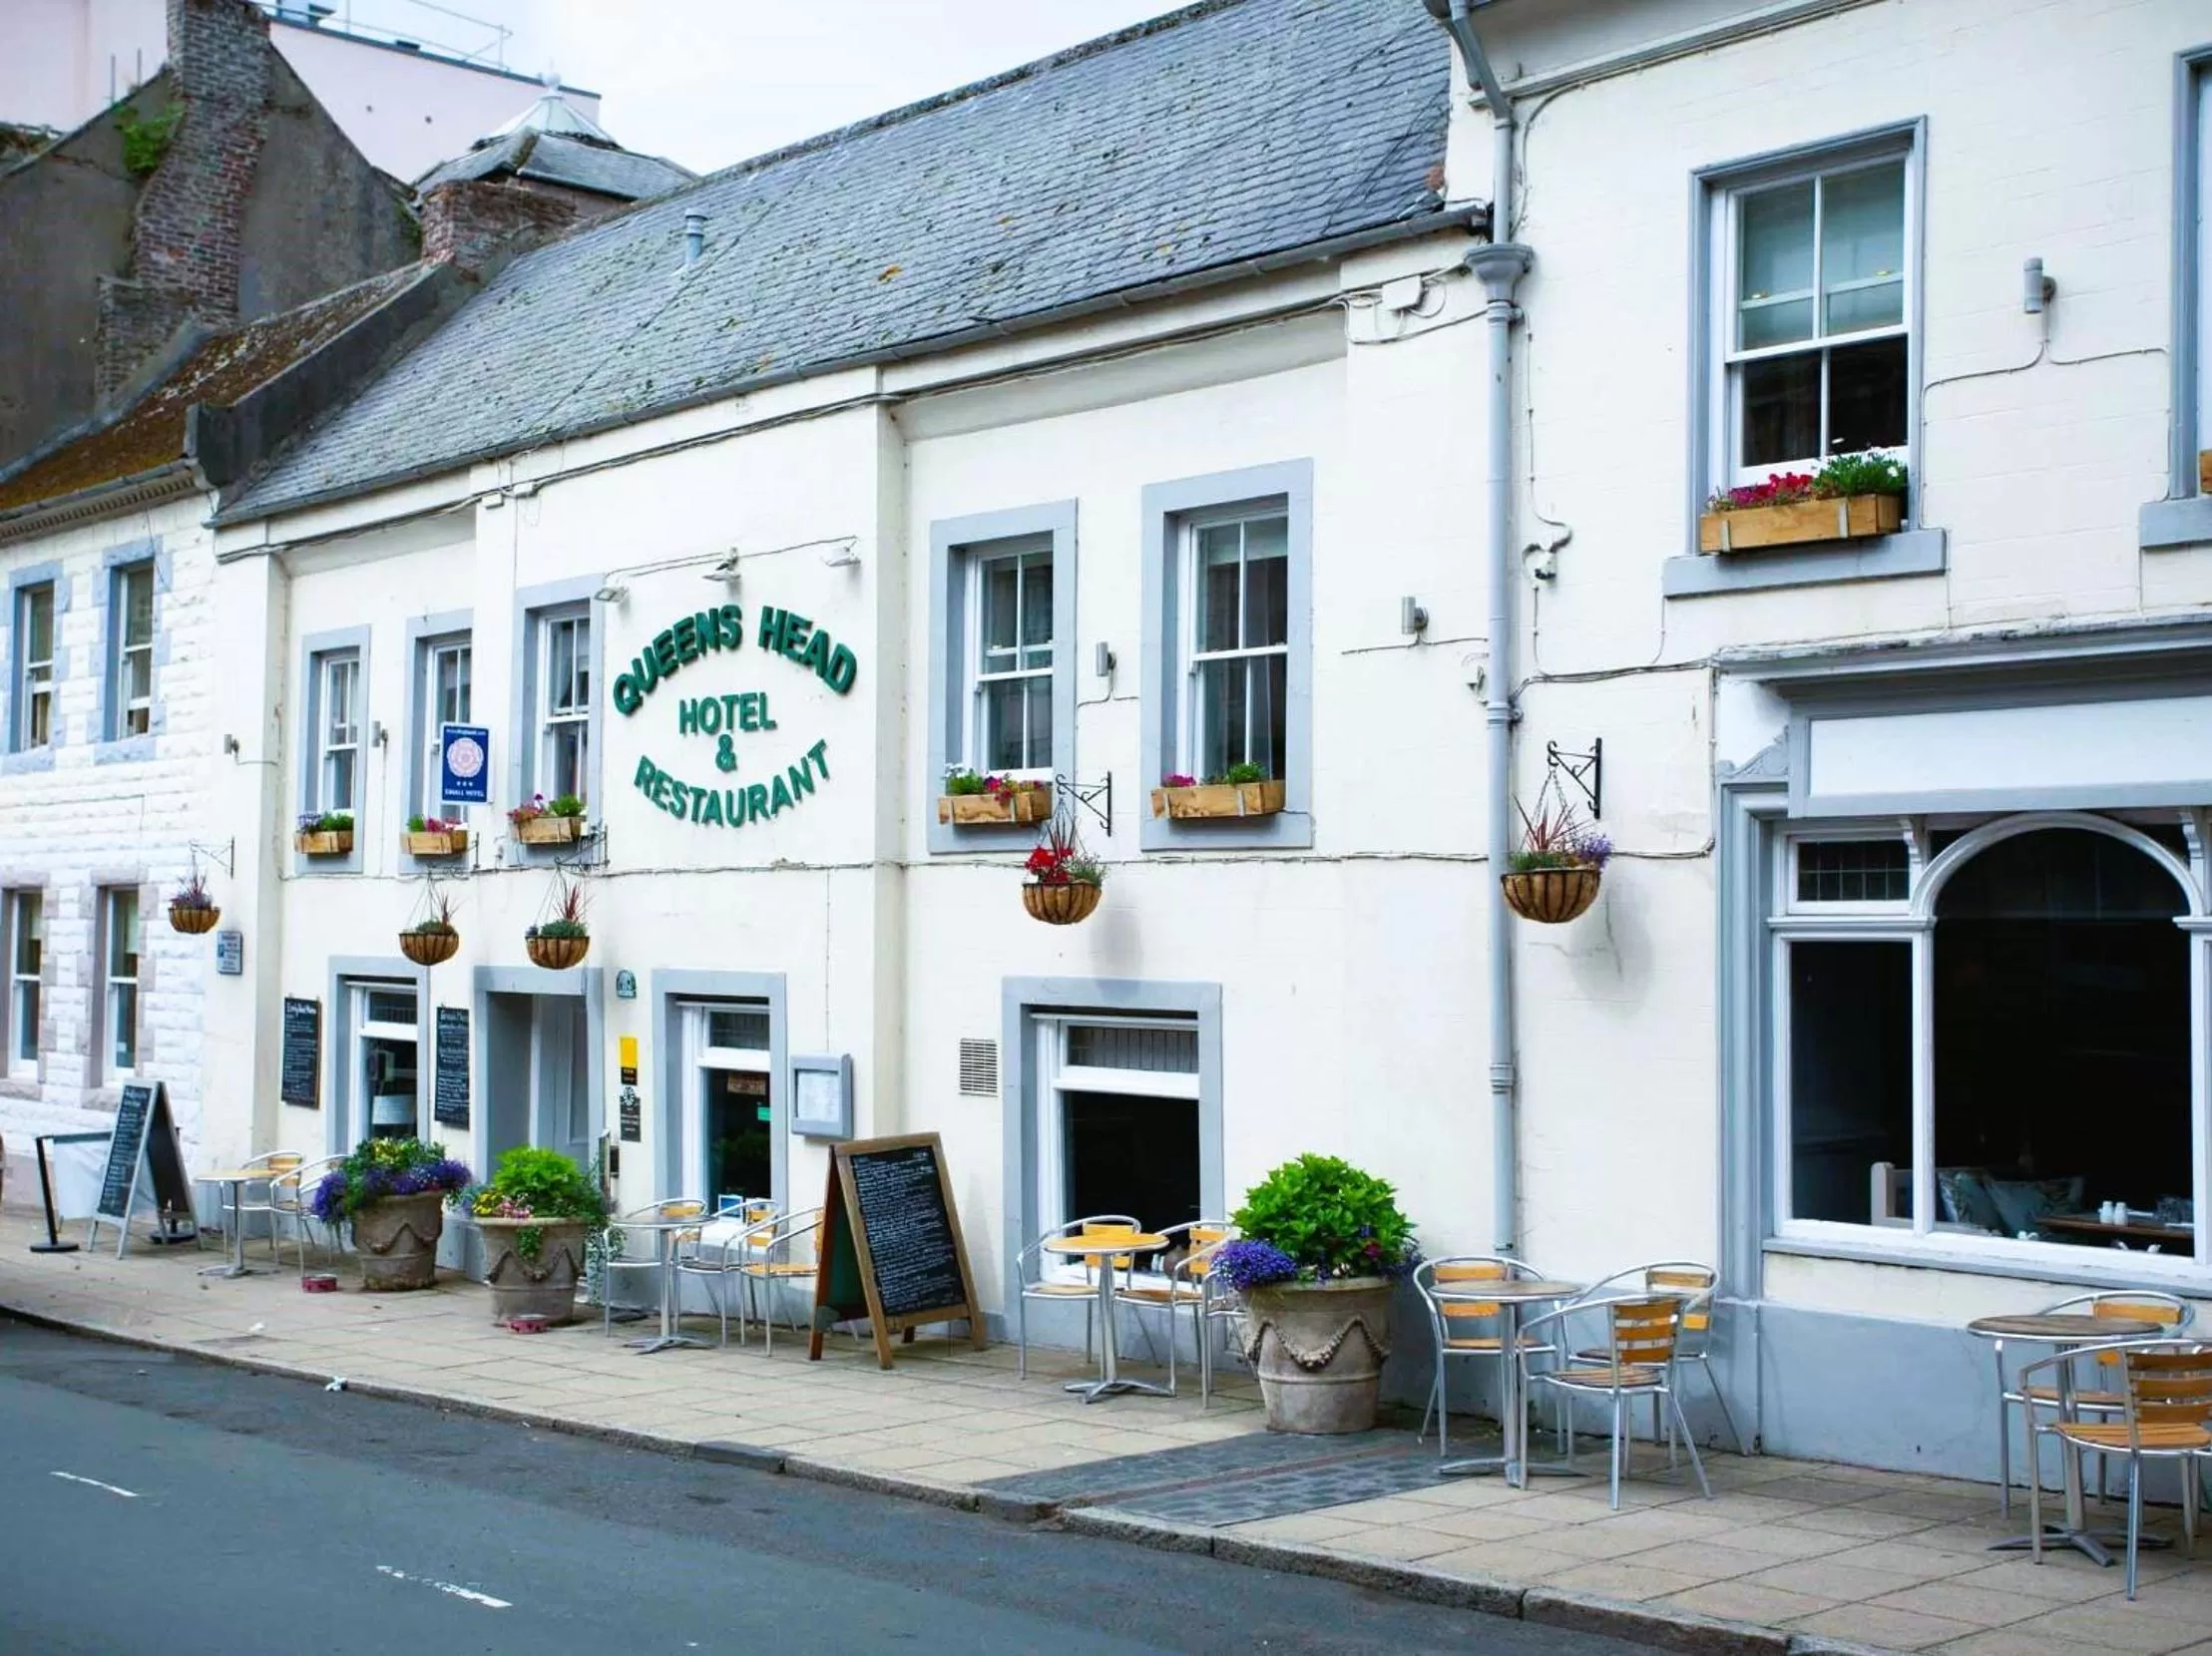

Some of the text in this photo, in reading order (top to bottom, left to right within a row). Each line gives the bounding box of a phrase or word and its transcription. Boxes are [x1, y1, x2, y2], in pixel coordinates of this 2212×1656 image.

[614, 605, 858, 716] QUEENS HEAD
[678, 693, 776, 735] HOTEL
[634, 739, 829, 828] RESTAURANT
[715, 734, 737, 772] &
